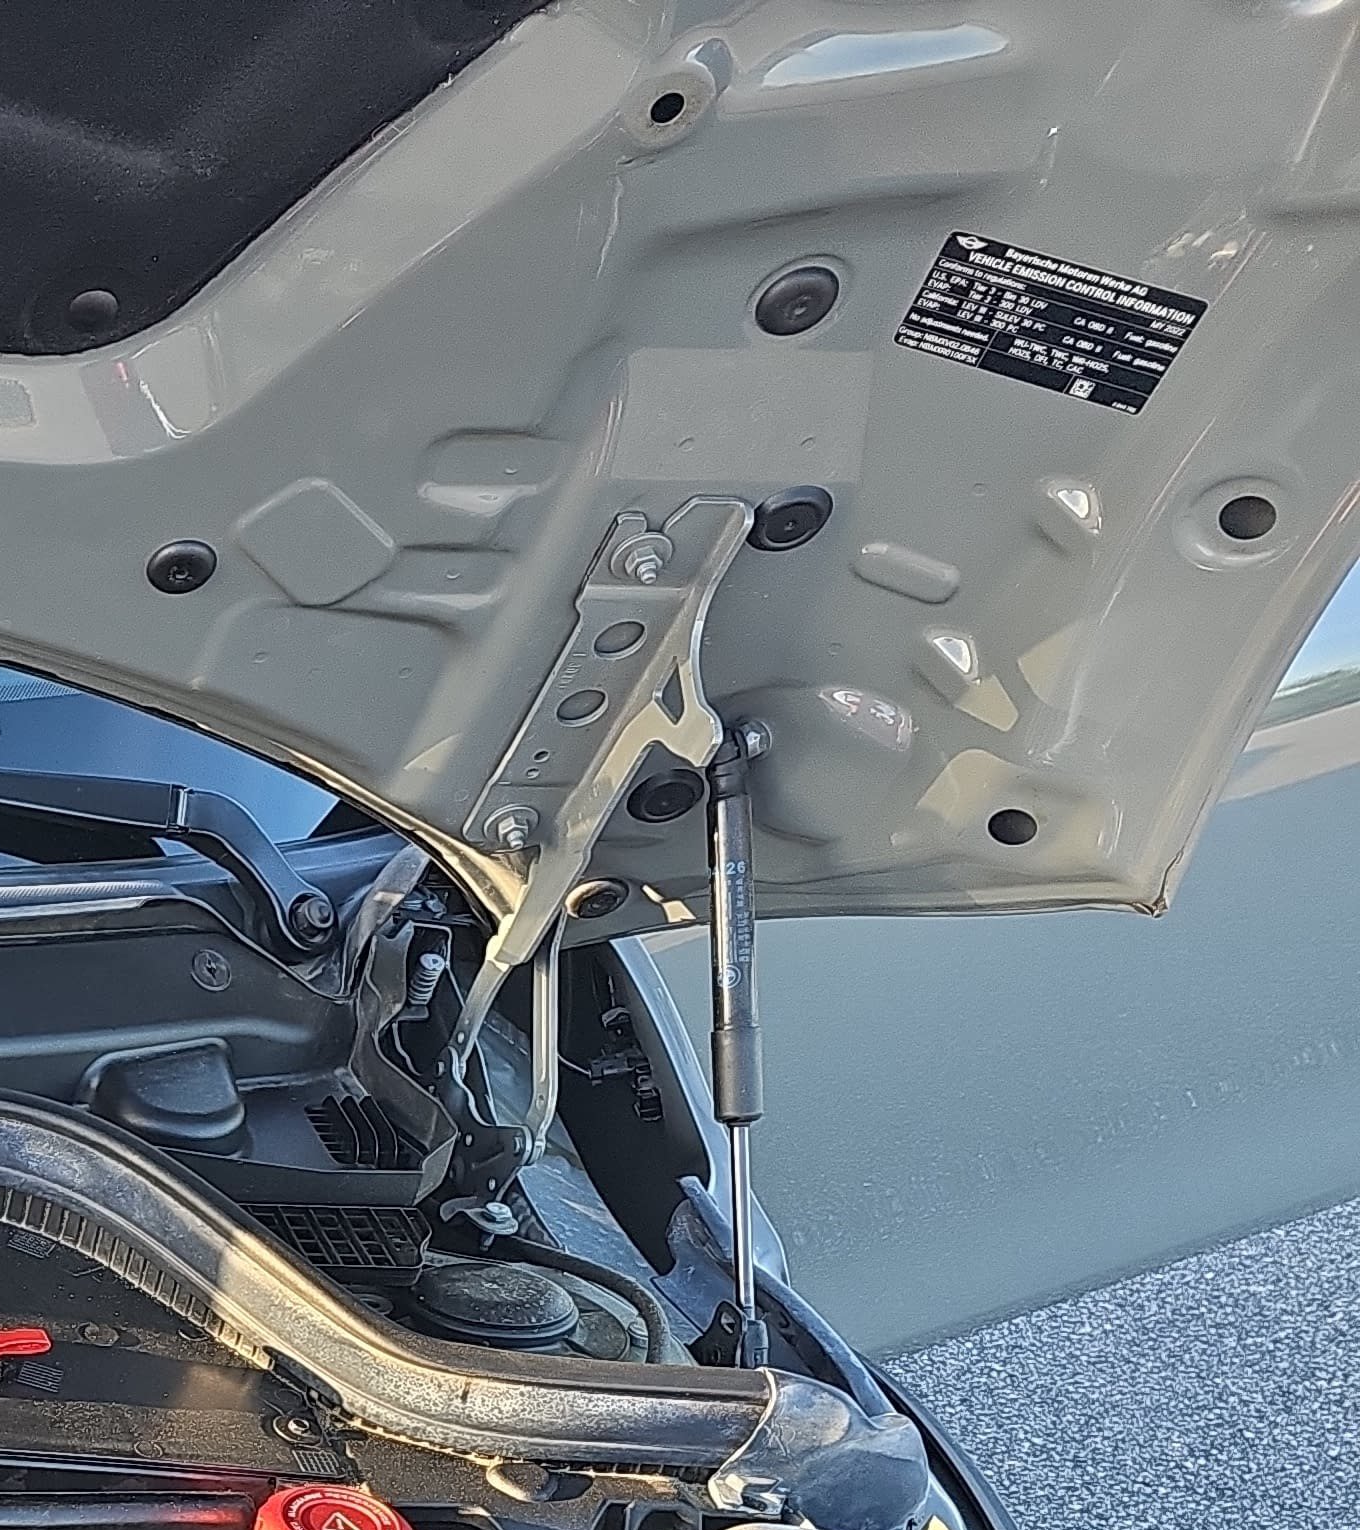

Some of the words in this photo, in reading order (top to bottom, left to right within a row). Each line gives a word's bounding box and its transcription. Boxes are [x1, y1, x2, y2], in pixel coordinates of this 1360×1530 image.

[967, 252, 1013, 271] VEHICLE
[1011, 264, 1066, 286] EMISSION
[1065, 280, 1118, 302] CONTROL
[1116, 294, 1195, 324] INFORMATION
[1004, 249, 1058, 271] Bayerische
[1057, 263, 1101, 282] Motoren
[1099, 276, 1132, 291] Werke
[1131, 285, 1148, 296] AG
[1163, 325, 1185, 336] 2022
